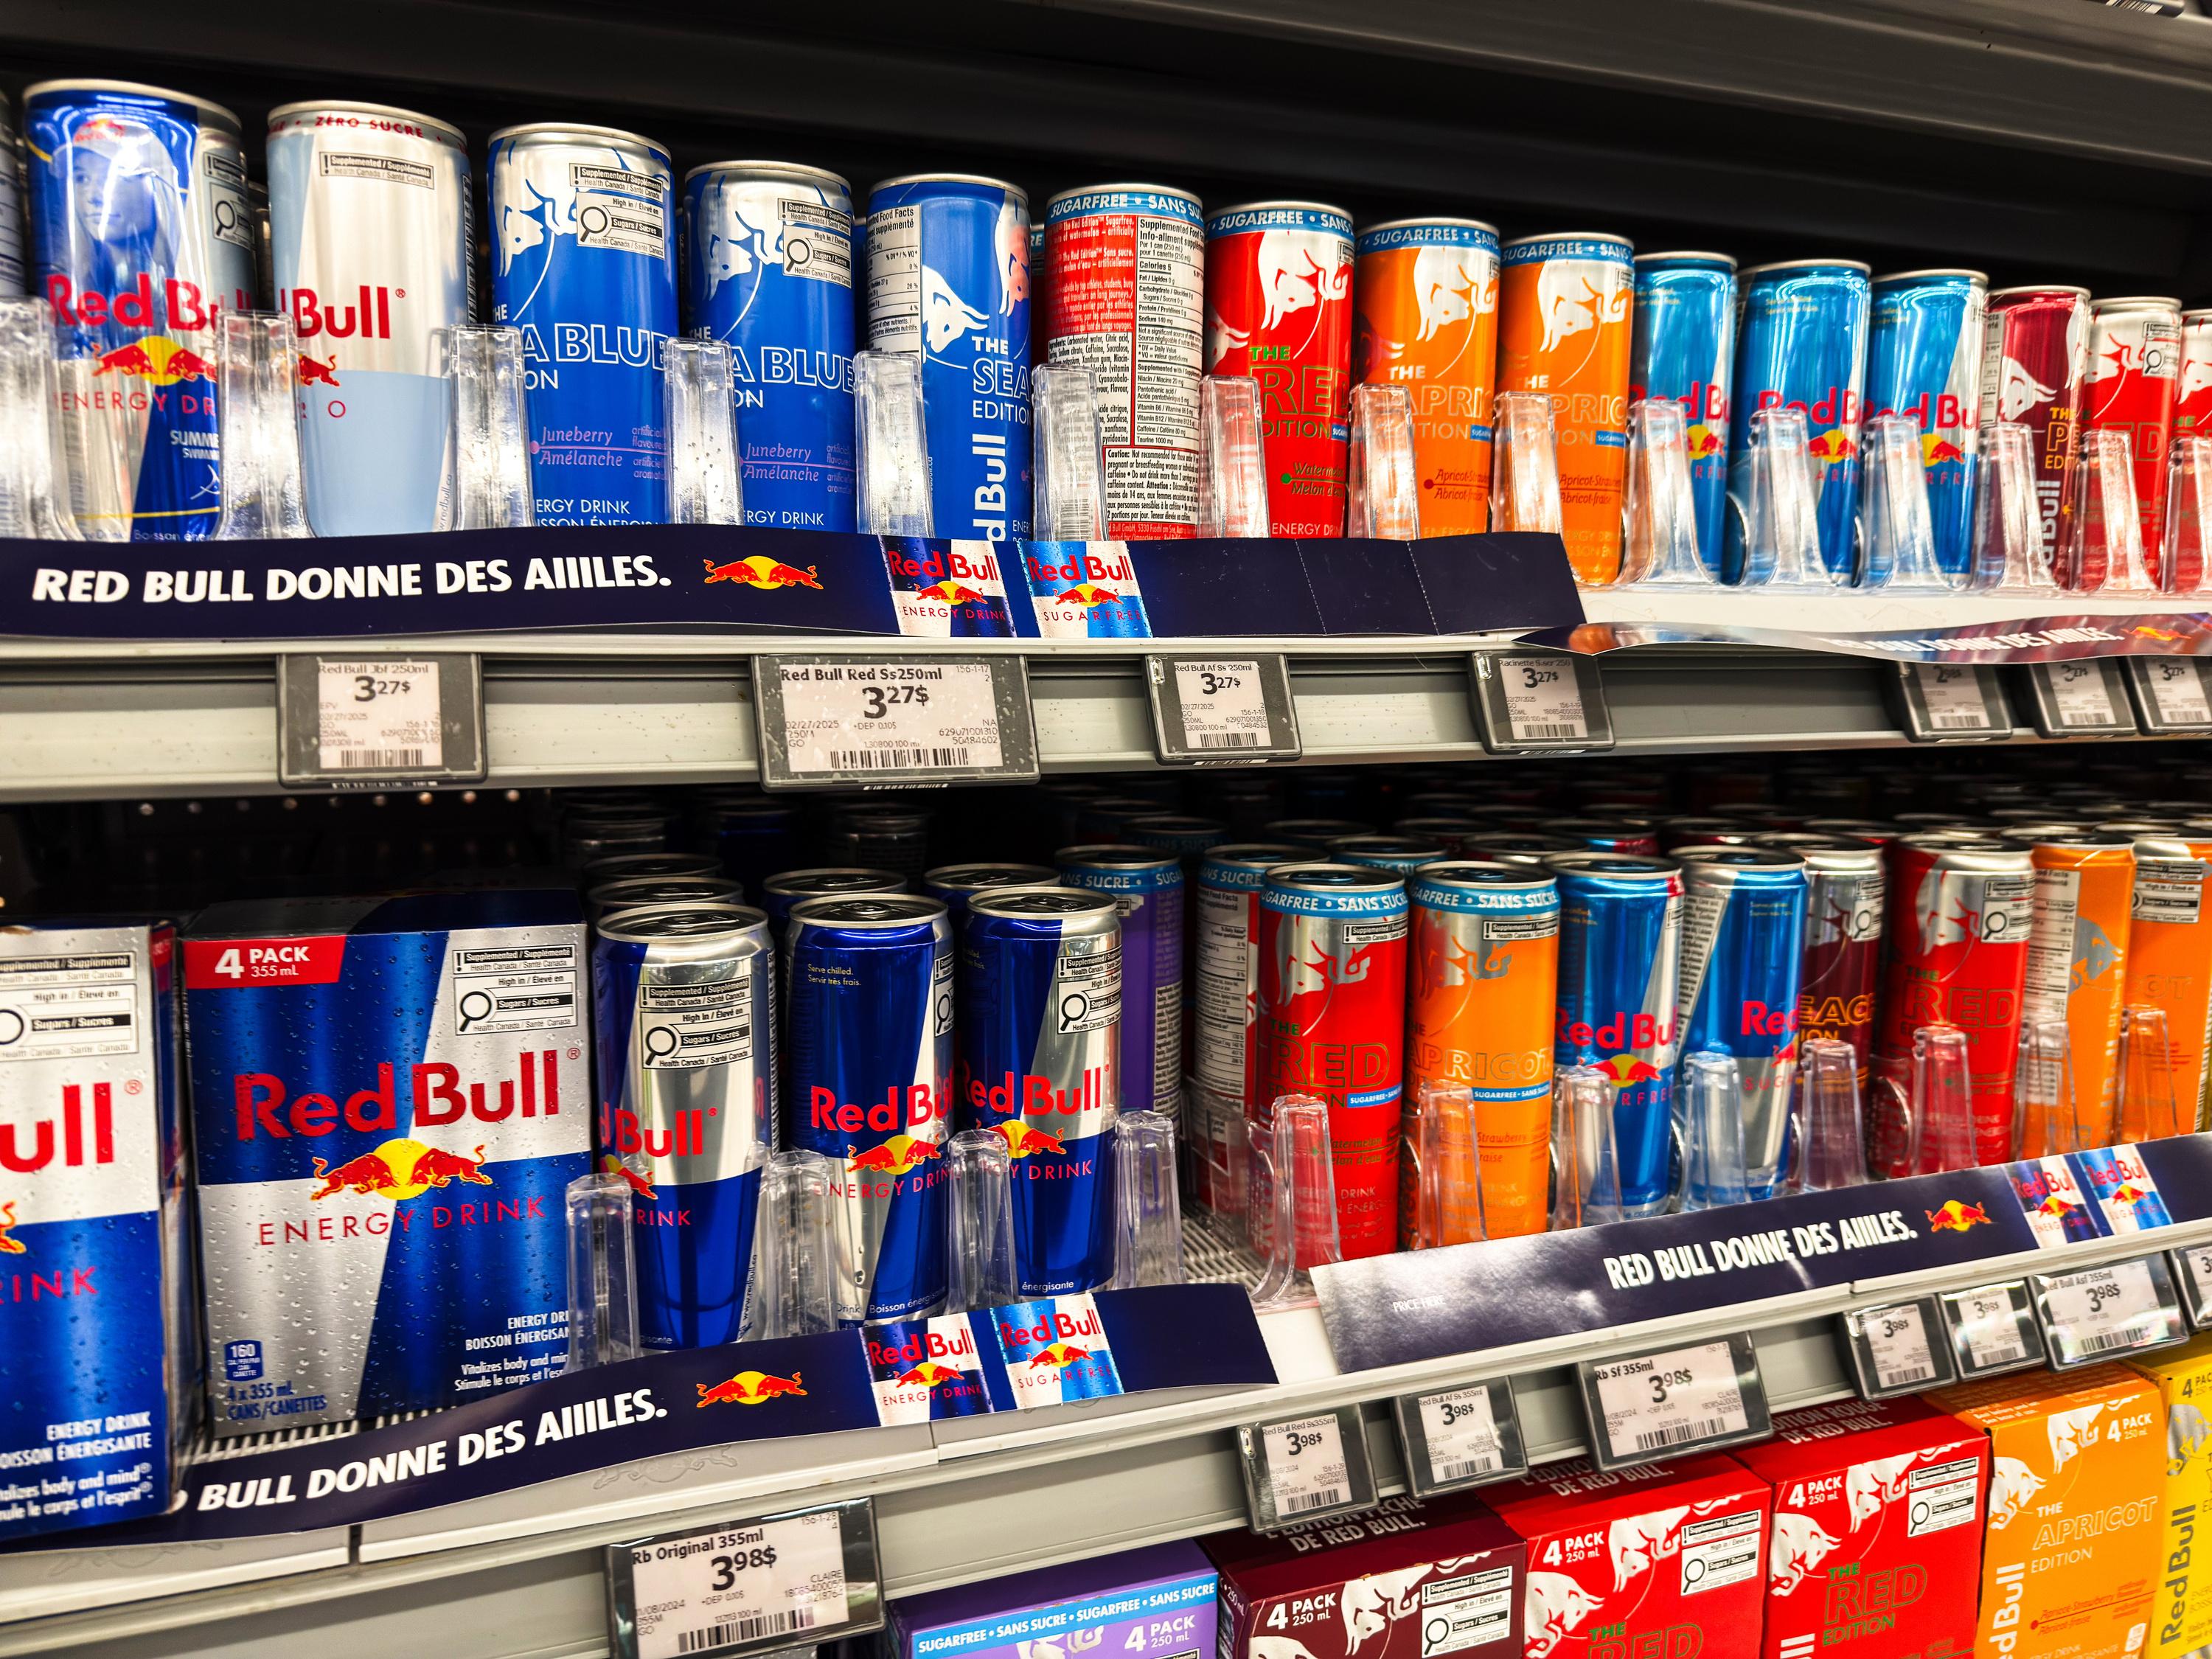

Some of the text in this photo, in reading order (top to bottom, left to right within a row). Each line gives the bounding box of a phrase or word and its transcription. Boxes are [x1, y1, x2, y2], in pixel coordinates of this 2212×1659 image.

[315, 114, 423, 138] ZÉRO SUCRE
[332, 156, 381, 167] Supplemented
[582, 168, 626, 180] Supplemented
[585, 178, 625, 190] Health Canada
[613, 198, 627, 207] High
[788, 204, 826, 216] Supplemented
[1050, 194, 1186, 218] SUGARFREE SANS
[880, 208, 914, 220] Food Facts
[1217, 212, 1303, 231] SUGARFREE
[613, 219, 656, 234] Sugars Sucres
[875, 219, 914, 234] supplémenté
[1140, 219, 1189, 236] Supplemented
[1373, 229, 1458, 246] SUGARFREE
[1502, 243, 1583, 262] SUGARFREE
[1139, 261, 1166, 271] Calories
[47, 272, 154, 328] Red
[972, 336, 1009, 355] THE
[1105, 333, 1117, 342] Citric
[1107, 344, 1130, 352] Sucralose,
[1251, 346, 1290, 361] THE
[542, 425, 613, 446] Juneberry
[539, 450, 623, 467] Amélanche
[745, 443, 811, 462] Juneberry
[1108, 450, 1130, 458] Caution:
[1141, 451, 1169, 459] recommended
[743, 465, 819, 481] Amélanche
[1107, 480, 1126, 488] caffeine
[1147, 481, 1168, 490] Attention
[1122, 490, 1128, 498] de
[1130, 490, 1135, 498] 14
[580, 499, 630, 514] DRINK
[1271, 523, 1321, 535] ENERGY
[888, 551, 999, 581] Red Bull
[1028, 554, 1133, 581] Red Bull
[32, 554, 672, 603] RED BULL DONNE DES AIIILES.
[902, 606, 1006, 621] ENERGY DRINK
[319, 665, 341, 673] Red
[344, 665, 367, 673] Bull
[781, 669, 810, 681] Red
[815, 668, 843, 681] Bull
[847, 668, 876, 680] Red
[1085, 874, 1130, 888] SUCRE
[1337, 897, 1380, 911] SANS
[215, 947, 310, 978] 4 PACK
[466, 952, 518, 961] Supplemented
[251, 965, 277, 978] 355
[808, 964, 854, 975] Serve chilled.
[650, 987, 702, 997] Supplemented
[498, 998, 559, 1008] Sugars Sucres
[683, 1031, 740, 1044] Sugars Sucres
[1269, 1040, 1390, 1088] RED
[233, 1049, 560, 1142] Red Bull
[1023, 1067, 1101, 1116] Bull
[811, 1085, 898, 1133] Red
[615, 1107, 703, 1158] Bull
[1029, 1160, 1092, 1179] DRINK
[258, 1197, 545, 1246] ENERGY DRINK
[1602, 1210, 1918, 1290] RED BULL DONNE DES AIIILES.
[1021, 1281, 1074, 1292] énergisante
[869, 1303, 905, 1314] Boisson
[1393, 1295, 1445, 1312] PRICE HERE
[507, 1312, 548, 1329] ENERGY
[465, 1335, 512, 1351] BOISSON
[1623, 1360, 1655, 1374] 355ml
[2107, 1413, 2152, 1442] 4 PACK
[197, 1388, 668, 1511] BULL DONNE DES AIIILES.
[1788, 1475, 1843, 1508] 4 PACK
[2036, 1501, 2063, 1517] THE
[2032, 1496, 2158, 1551] APRICOT
[632, 1528, 764, 1565] Rb Original 355ml
[2031, 1546, 2093, 1573] EDITION
[1827, 1562, 1860, 1580] THE
[1824, 1564, 1927, 1625] RED
[918, 1583, 1215, 1652] SUGARFREE SANS SUCRE SUGARFREE SANS SUCRE
[1266, 1593, 1337, 1630] 4 PACK
[1124, 1615, 1196, 1652] 4 PACK
[1822, 1613, 1896, 1646] EDITION
[1150, 1635, 1173, 1649] 250
